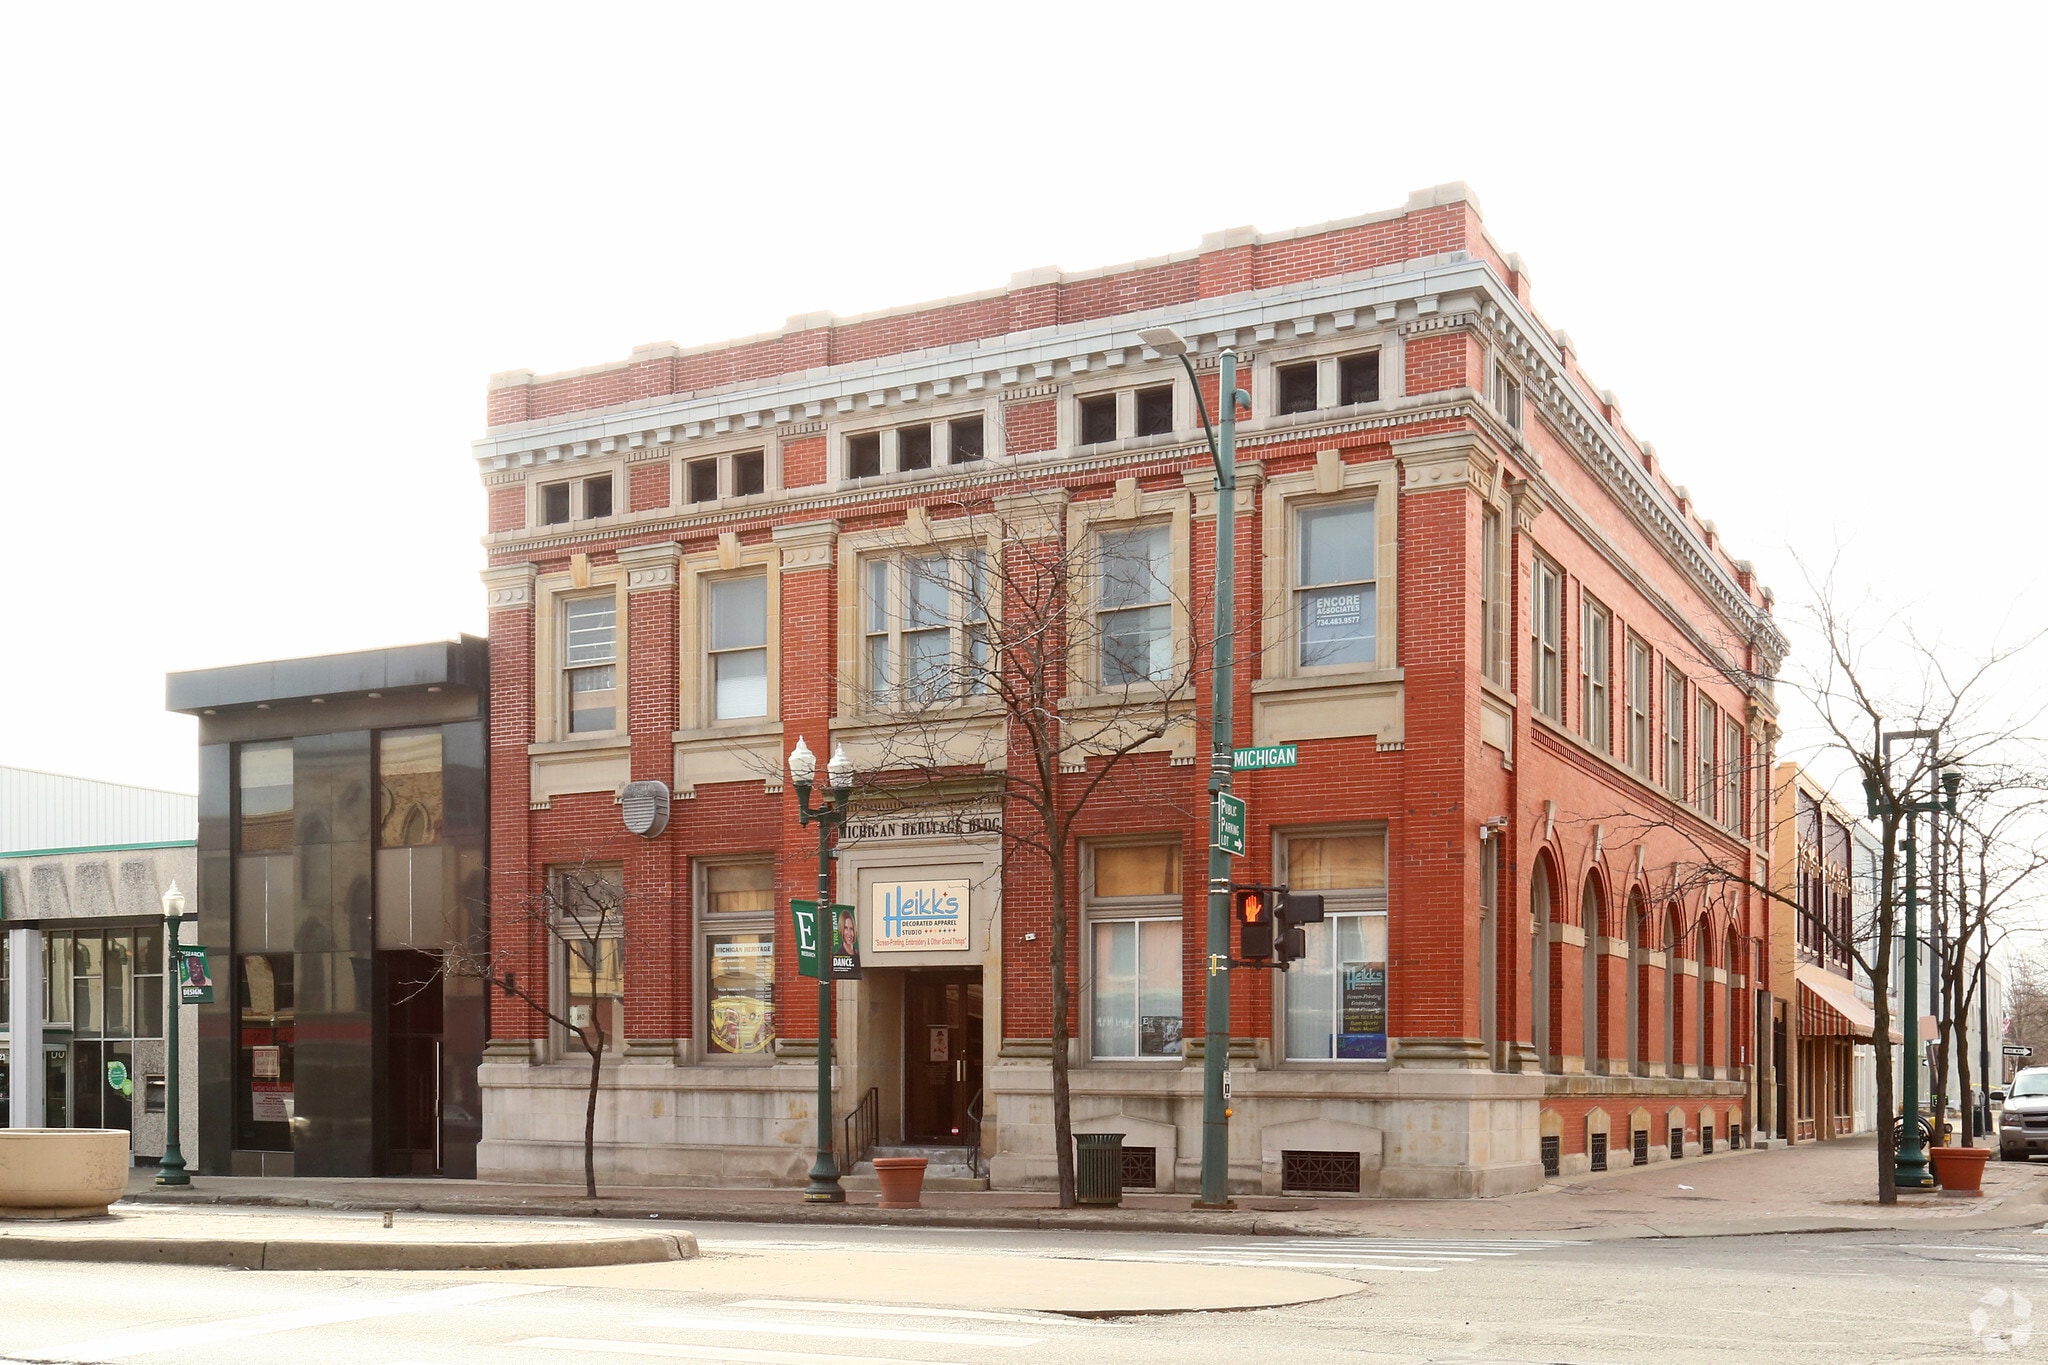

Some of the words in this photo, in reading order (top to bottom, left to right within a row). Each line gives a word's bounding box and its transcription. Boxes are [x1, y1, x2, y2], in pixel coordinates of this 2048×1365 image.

[1316, 594, 1360, 608] ENCORE
[1316, 604, 1360, 615] ASSOCIATES
[1316, 616, 1360, 627] 734.483.9577
[1234, 748, 1296, 767] MICHIGAN
[838, 823, 896, 840] MICHIGAN
[902, 820, 963, 836] HERITAGE
[1220, 834, 1230, 847] LOT
[796, 912, 816, 950] E
[833, 958, 855, 967] DANCE.
